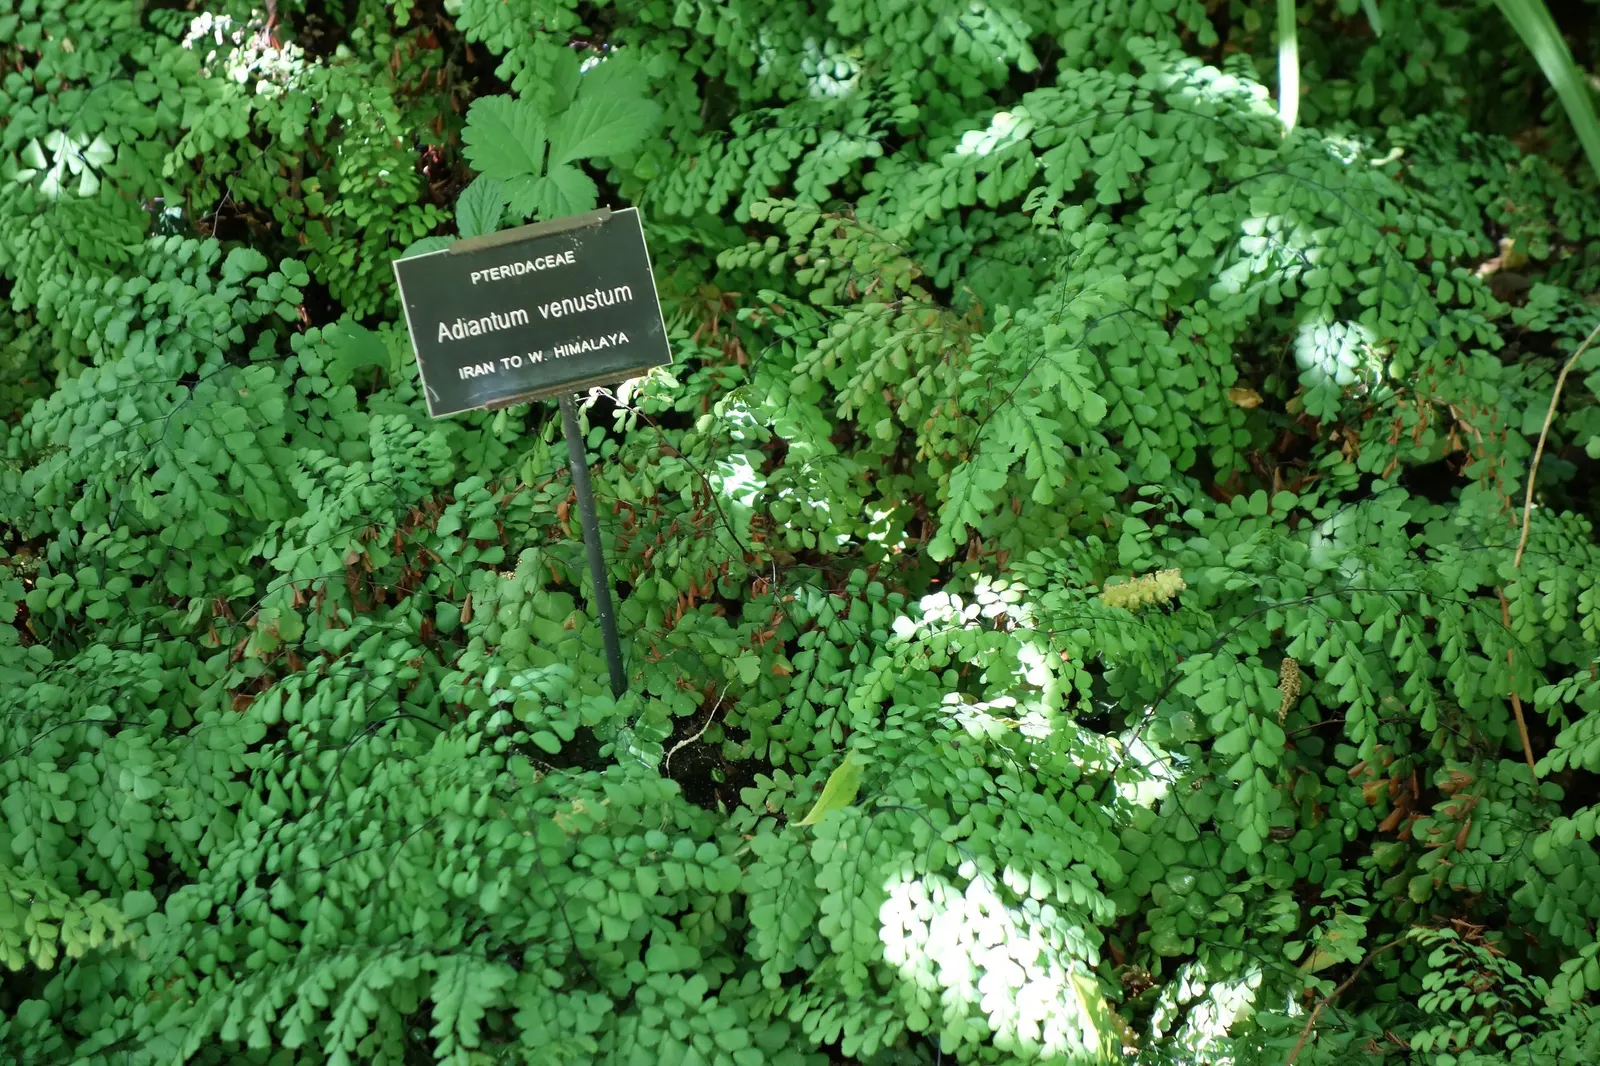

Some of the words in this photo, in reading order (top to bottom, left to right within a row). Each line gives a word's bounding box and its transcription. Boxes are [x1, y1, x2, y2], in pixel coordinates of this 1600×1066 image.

[470, 251, 576, 284] PTERIDACEAE
[438, 308, 529, 343] Adiantum
[538, 285, 633, 320] venustum
[458, 361, 495, 380] IRAN
[500, 355, 522, 370] TO
[528, 350, 548, 363] W.
[553, 332, 630, 358] HIMALAYA
